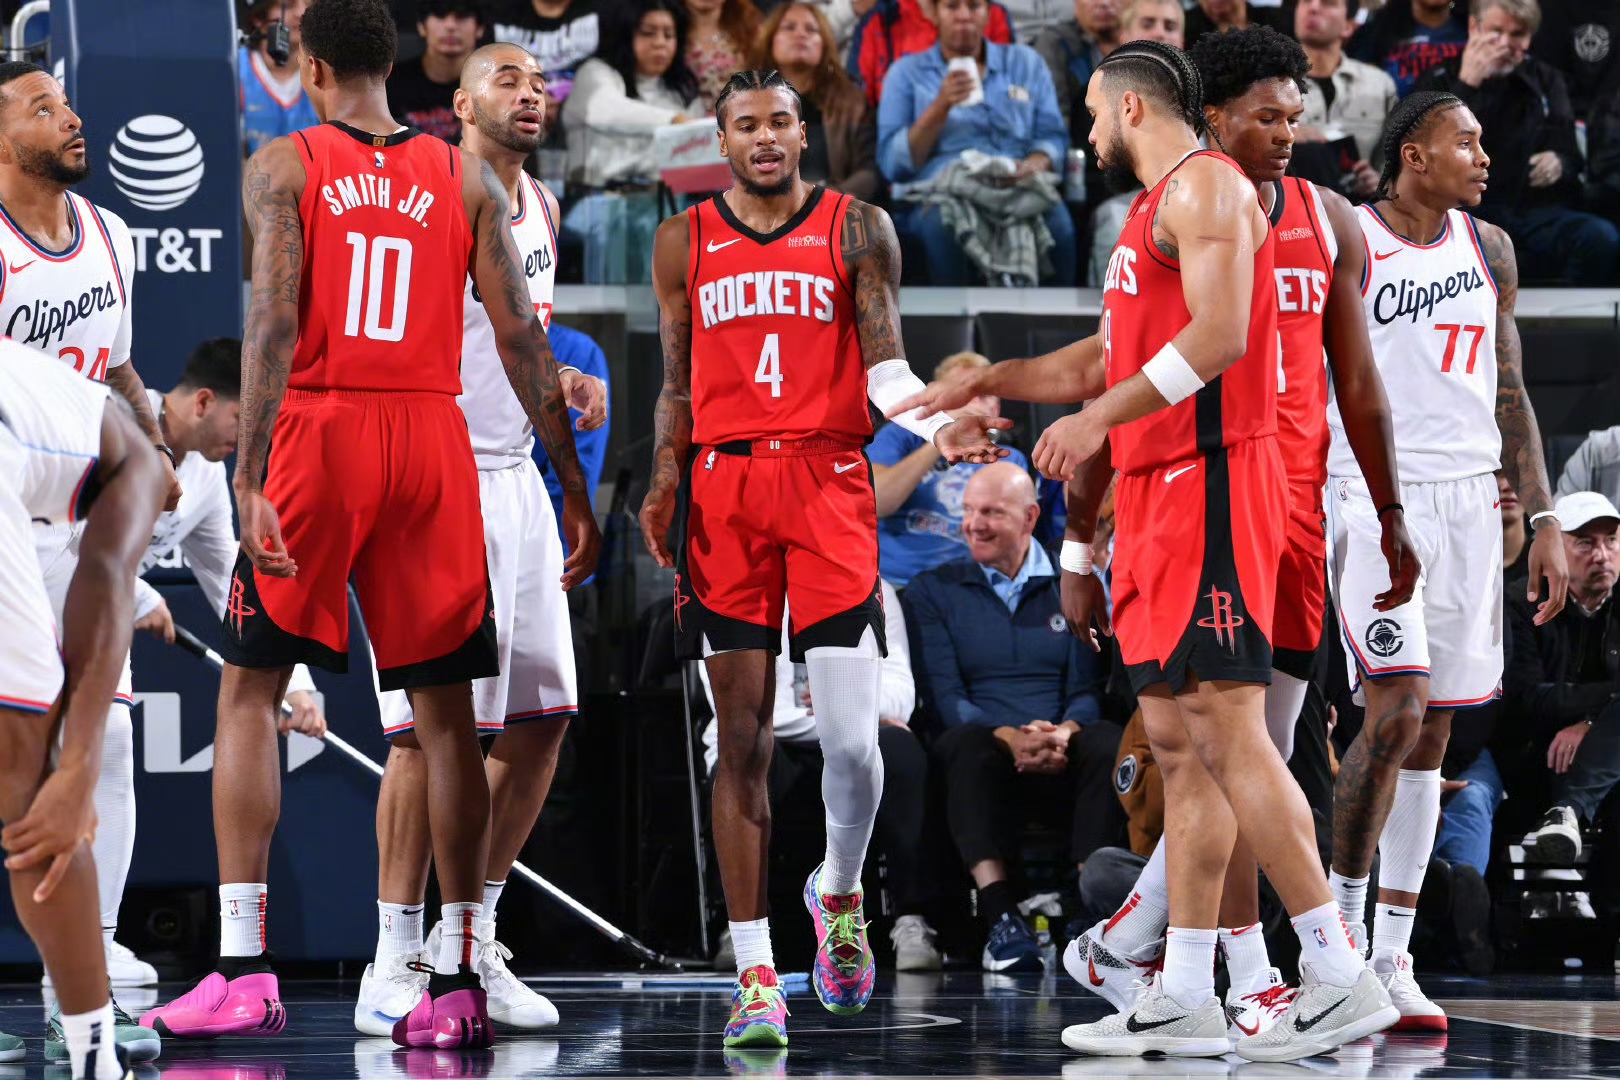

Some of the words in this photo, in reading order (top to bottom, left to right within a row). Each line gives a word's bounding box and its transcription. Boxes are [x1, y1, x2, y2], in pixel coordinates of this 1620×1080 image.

[322, 174, 391, 216] SMITH
[397, 184, 435, 228] JR.
[128, 227, 223, 273] T&T
[788, 240, 828, 248] HERMANN
[5, 281, 117, 349] Clippers
[344, 231, 413, 342] 10
[698, 271, 835, 329] ROCKETS
[1374, 266, 1484, 325] Clippers
[754, 333, 784, 397] 4
[1434, 324, 1486, 374] 77
